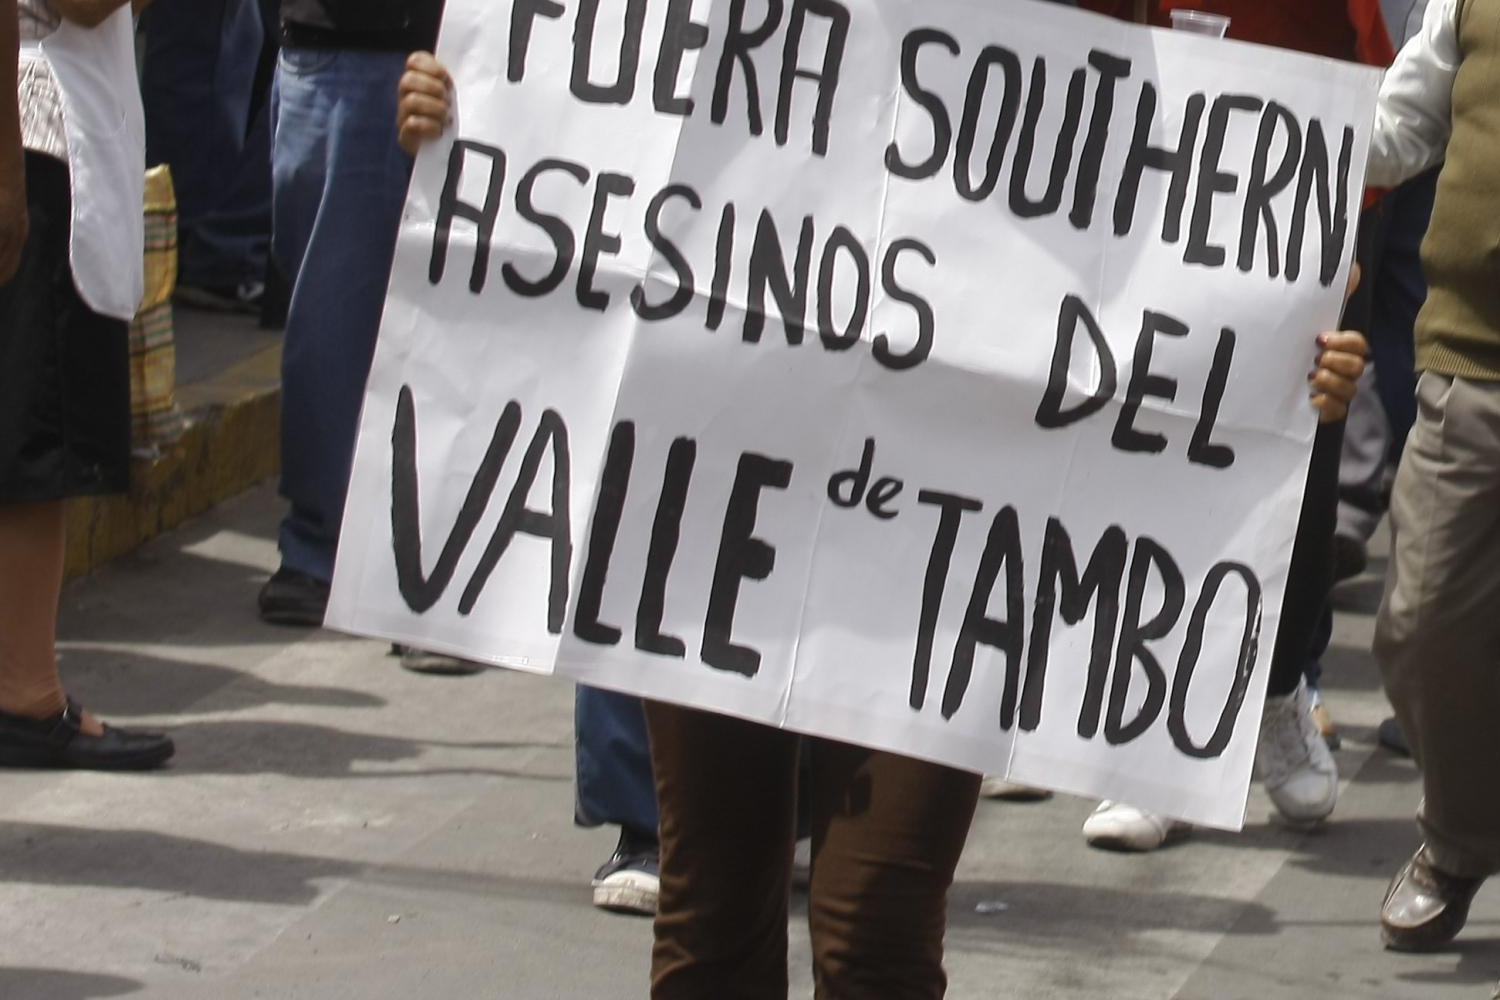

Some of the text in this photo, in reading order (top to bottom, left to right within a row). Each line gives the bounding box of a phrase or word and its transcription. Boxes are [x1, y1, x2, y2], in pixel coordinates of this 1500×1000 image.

[428, 139, 1236, 469] ASESINOS DEL
[885, 28, 1354, 285] SOUTHERN
[391, 385, 1262, 759] VALLE de TAMBO
